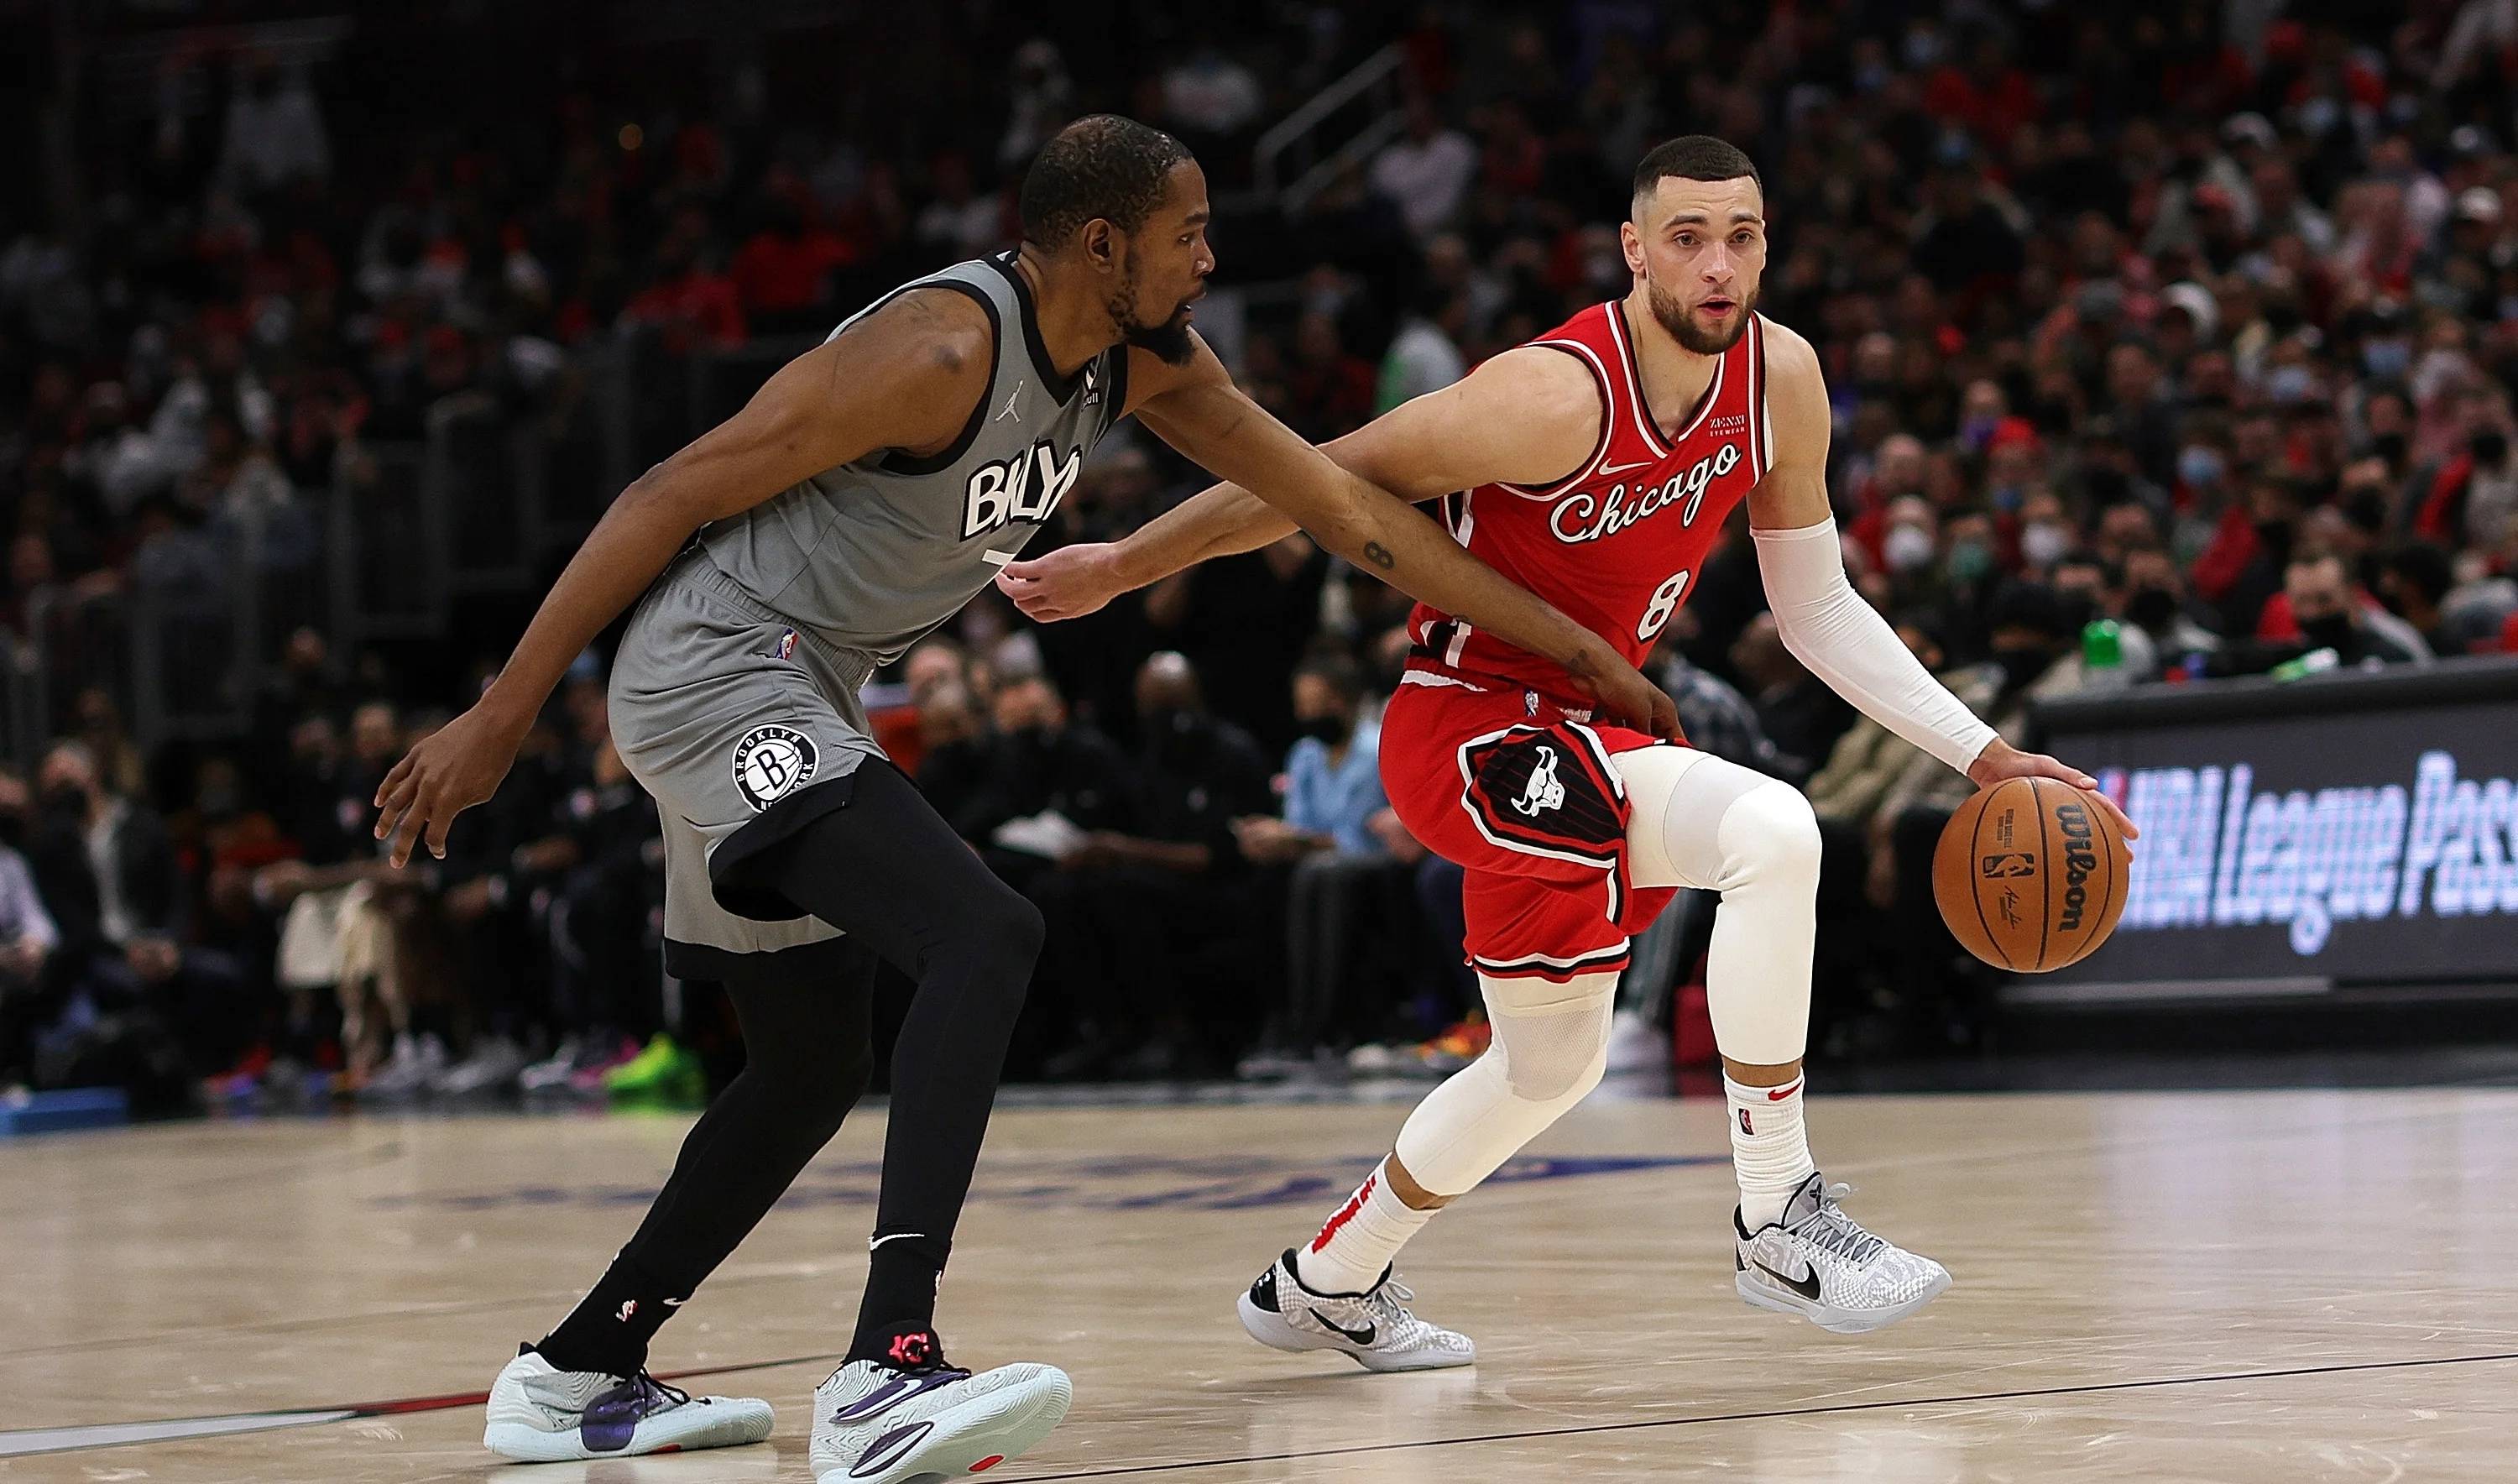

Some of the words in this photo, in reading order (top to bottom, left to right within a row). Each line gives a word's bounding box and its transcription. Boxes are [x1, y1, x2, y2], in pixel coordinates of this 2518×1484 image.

[1550, 443, 1742, 543] Chicago
[1637, 569, 1690, 641] 8
[735, 729, 802, 782] BROOKLYN
[755, 749, 787, 790] B
[2056, 802, 2097, 932] Wilson
[2212, 764, 2409, 956] League
